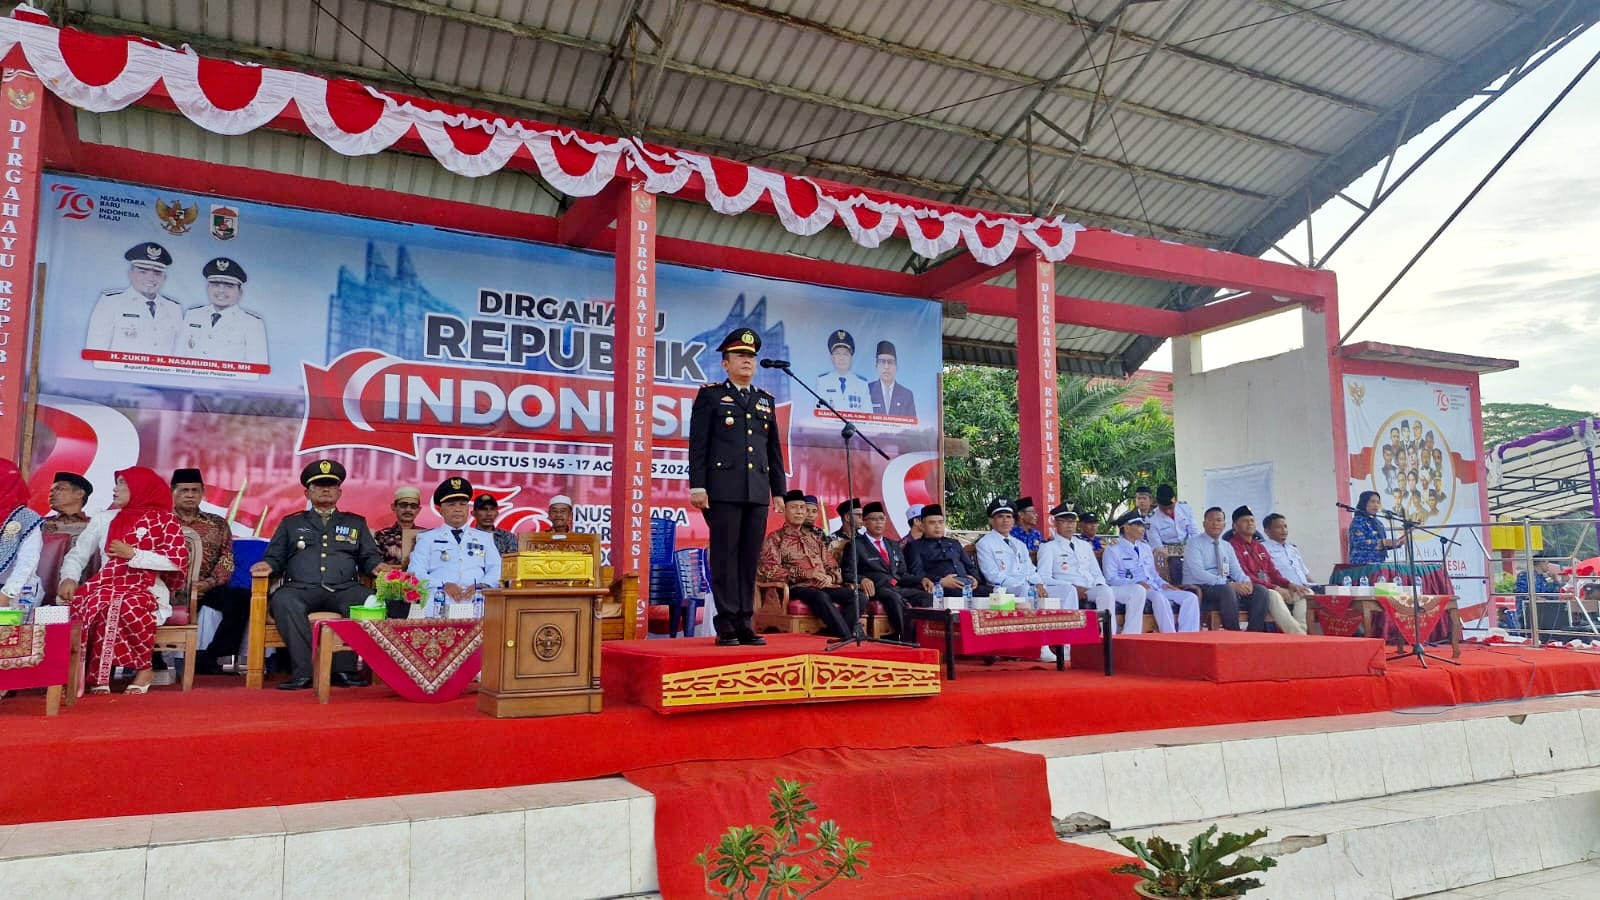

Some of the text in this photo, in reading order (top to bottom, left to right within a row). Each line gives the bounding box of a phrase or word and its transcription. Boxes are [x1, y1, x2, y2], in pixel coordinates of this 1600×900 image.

[99, 208, 139, 218] INDONESIA
[100, 195, 146, 206] NUSANTARA
[0, 119, 26, 416] DIRGAHAYU REPUB
[636, 220, 648, 337] DIRGAHAYU
[479, 289, 665, 333] DIRGAH
[1041, 282, 1052, 380] DIRGAHAYU
[121, 354, 150, 362] ZUKRI
[237, 363, 251, 371] MH
[427, 315, 704, 379] REPUBIK
[383, 373, 692, 437] INDONSI
[634, 346, 647, 452] REPUBLIK
[1044, 386, 1055, 475] REPUBLIK
[436, 453, 452, 465] 17
[455, 454, 529, 468] AGUSTUS
[532, 457, 565, 469] 1945
[576, 459, 590, 470] 17
[660, 464, 691, 475] 2024
[575, 507, 688, 525] NUSARA
[575, 526, 612, 541] BAR
[631, 461, 644, 584] INDONESI
